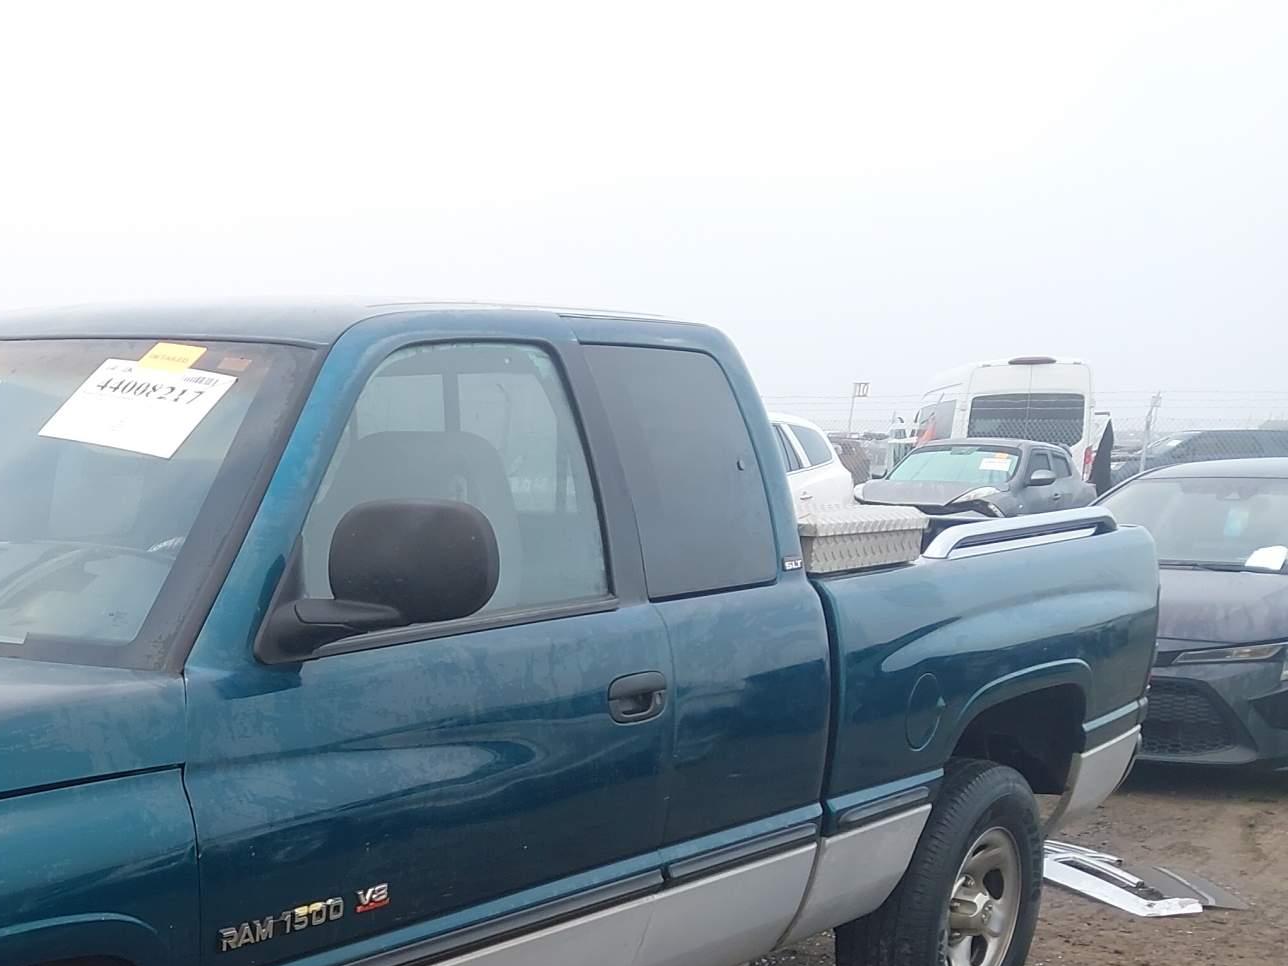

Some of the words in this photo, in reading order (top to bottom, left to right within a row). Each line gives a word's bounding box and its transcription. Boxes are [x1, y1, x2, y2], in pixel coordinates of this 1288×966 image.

[96, 377, 205, 405] 44008217
[784, 559, 802, 571] SLT
[219, 914, 274, 952] RAM
[279, 896, 345, 934] 1500
[356, 882, 389, 906] V8
